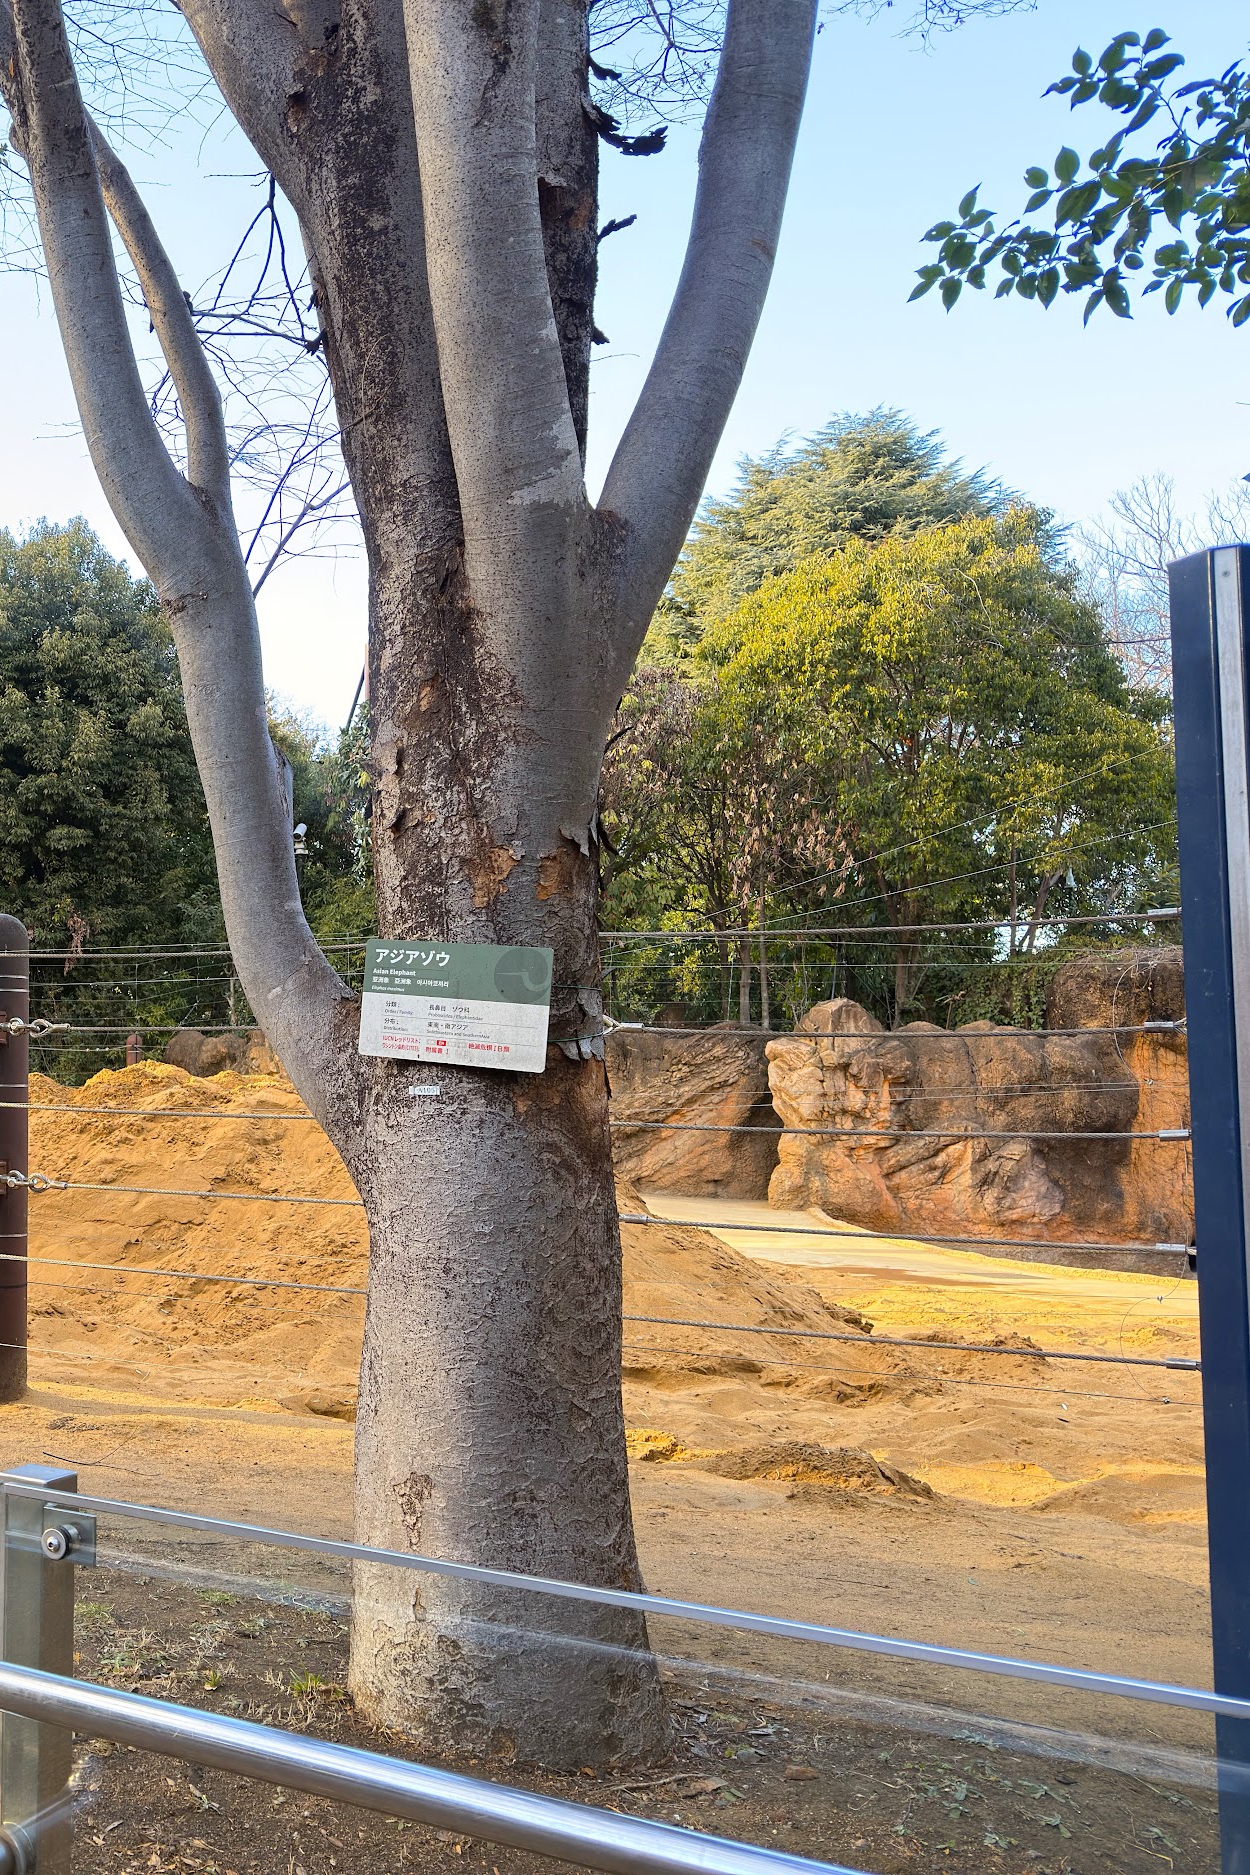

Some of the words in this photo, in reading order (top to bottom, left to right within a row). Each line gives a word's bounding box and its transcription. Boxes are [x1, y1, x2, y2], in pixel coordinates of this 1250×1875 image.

[375, 948, 451, 967] アジアゾウ
[390, 968, 416, 976] Elephant
